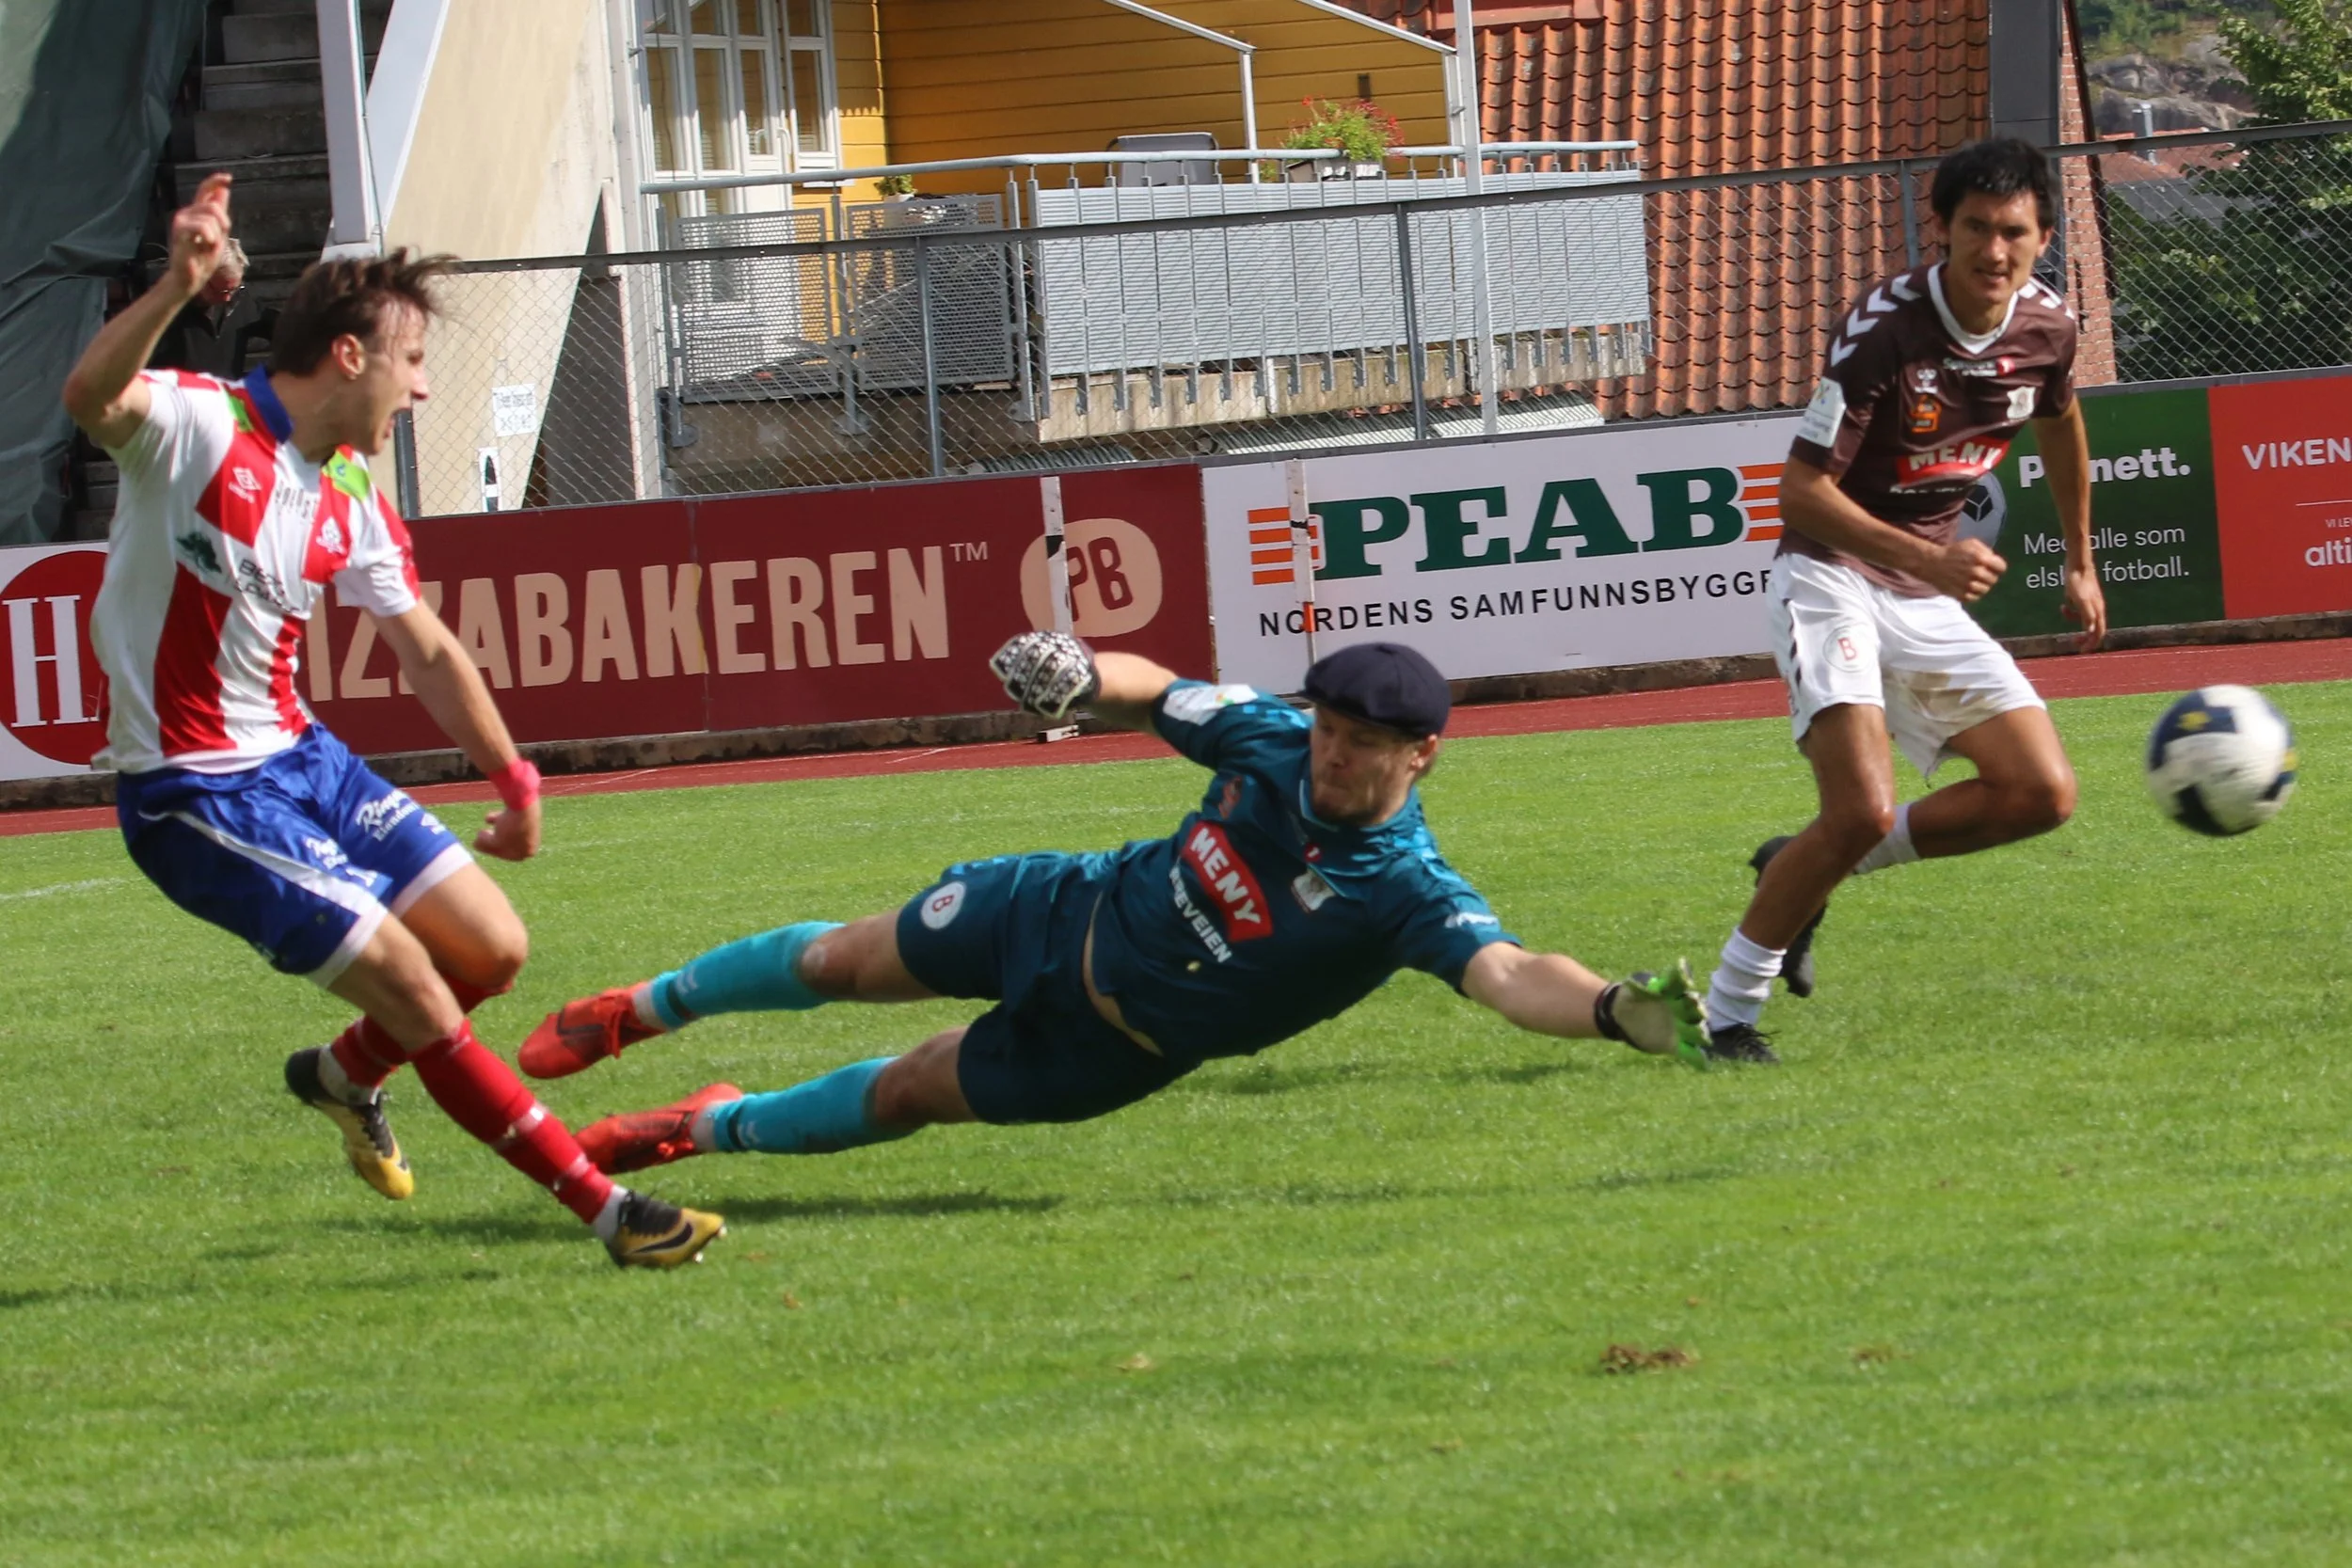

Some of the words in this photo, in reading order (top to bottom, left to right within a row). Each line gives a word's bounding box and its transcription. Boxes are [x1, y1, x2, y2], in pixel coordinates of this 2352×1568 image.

[1909, 442, 2002, 471] MENY
[2018, 447, 2191, 487] Pnett.
[2241, 437, 2352, 470] VIKEN
[1309, 467, 1744, 581] PEAB
[2089, 529, 2128, 550] alle
[2134, 526, 2185, 546] som
[2326, 518, 2336, 529] VI
[2103, 555, 2190, 582] fotball.
[2305, 537, 2352, 567] alti
[1066, 536, 1134, 622] PB
[305, 545, 949, 702] IZABAKEREN
[950, 541, 988, 562] TM
[1259, 598, 1433, 637] NORDENS
[2, 594, 100, 728] H
[1189, 827, 1262, 924] MENY
